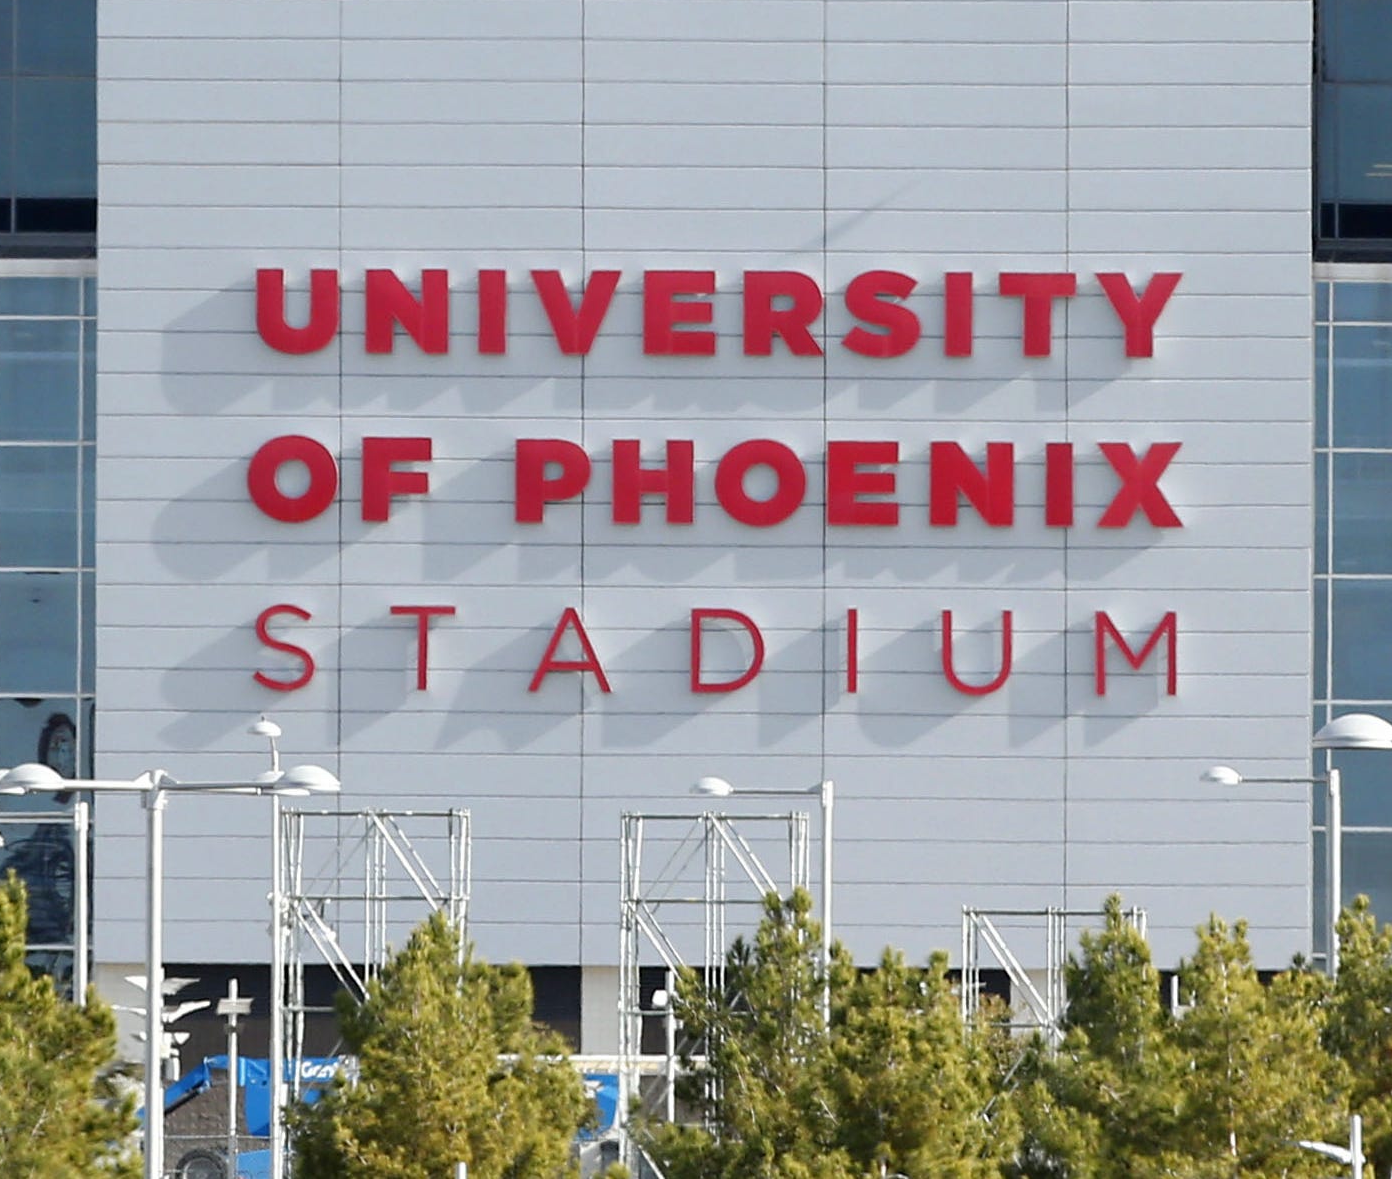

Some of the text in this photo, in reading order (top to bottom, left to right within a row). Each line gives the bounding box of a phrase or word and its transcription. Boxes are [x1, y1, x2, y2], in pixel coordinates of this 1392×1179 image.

[256, 268, 1183, 359] UNIVERSITY
[247, 435, 1184, 529] OF PHOENIX
[252, 603, 1179, 697] STADIUM
